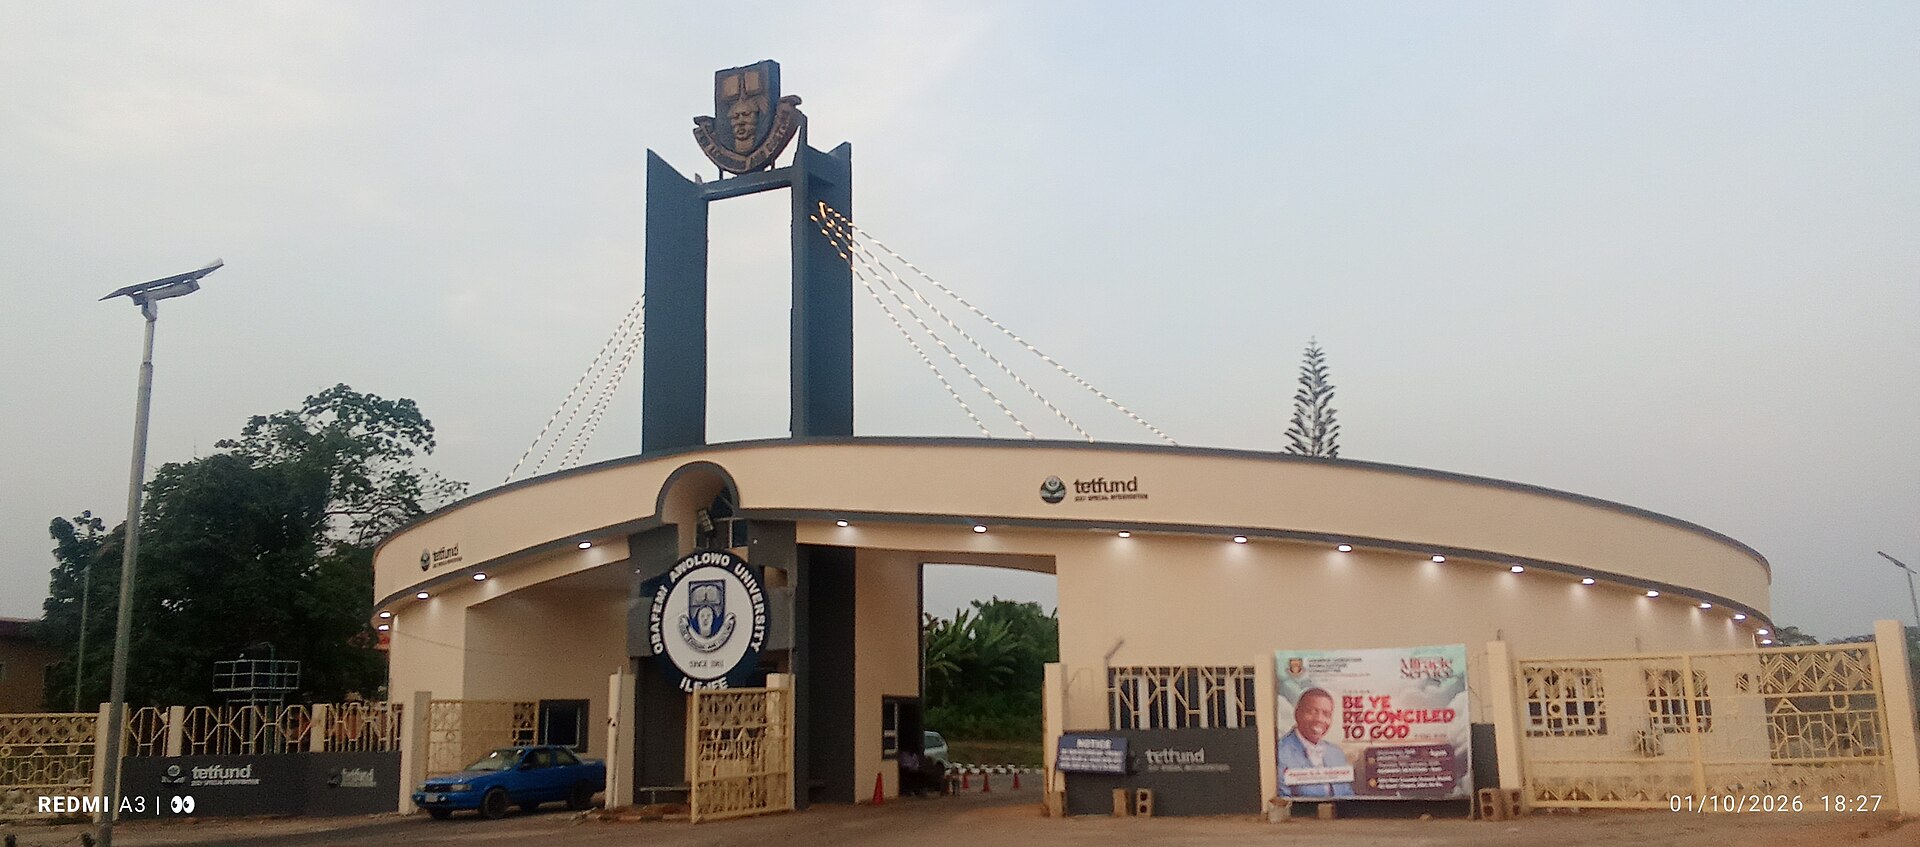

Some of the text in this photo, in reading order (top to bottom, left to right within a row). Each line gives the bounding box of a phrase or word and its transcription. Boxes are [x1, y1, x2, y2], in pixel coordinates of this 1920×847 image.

[1073, 475, 1138, 494] tetfund
[650, 584, 669, 655] OBAFEMI
[669, 552, 731, 583] AWOLOWO
[734, 563, 766, 654] UNIVERSITY
[1342, 695, 1391, 709] BE YE
[1342, 709, 1456, 724] RECONCILED
[1342, 724, 1410, 739] TO GOD
[1076, 738, 1112, 749] NOTICE
[1145, 747, 1205, 764] tetfund
[191, 763, 253, 780] tetfund
